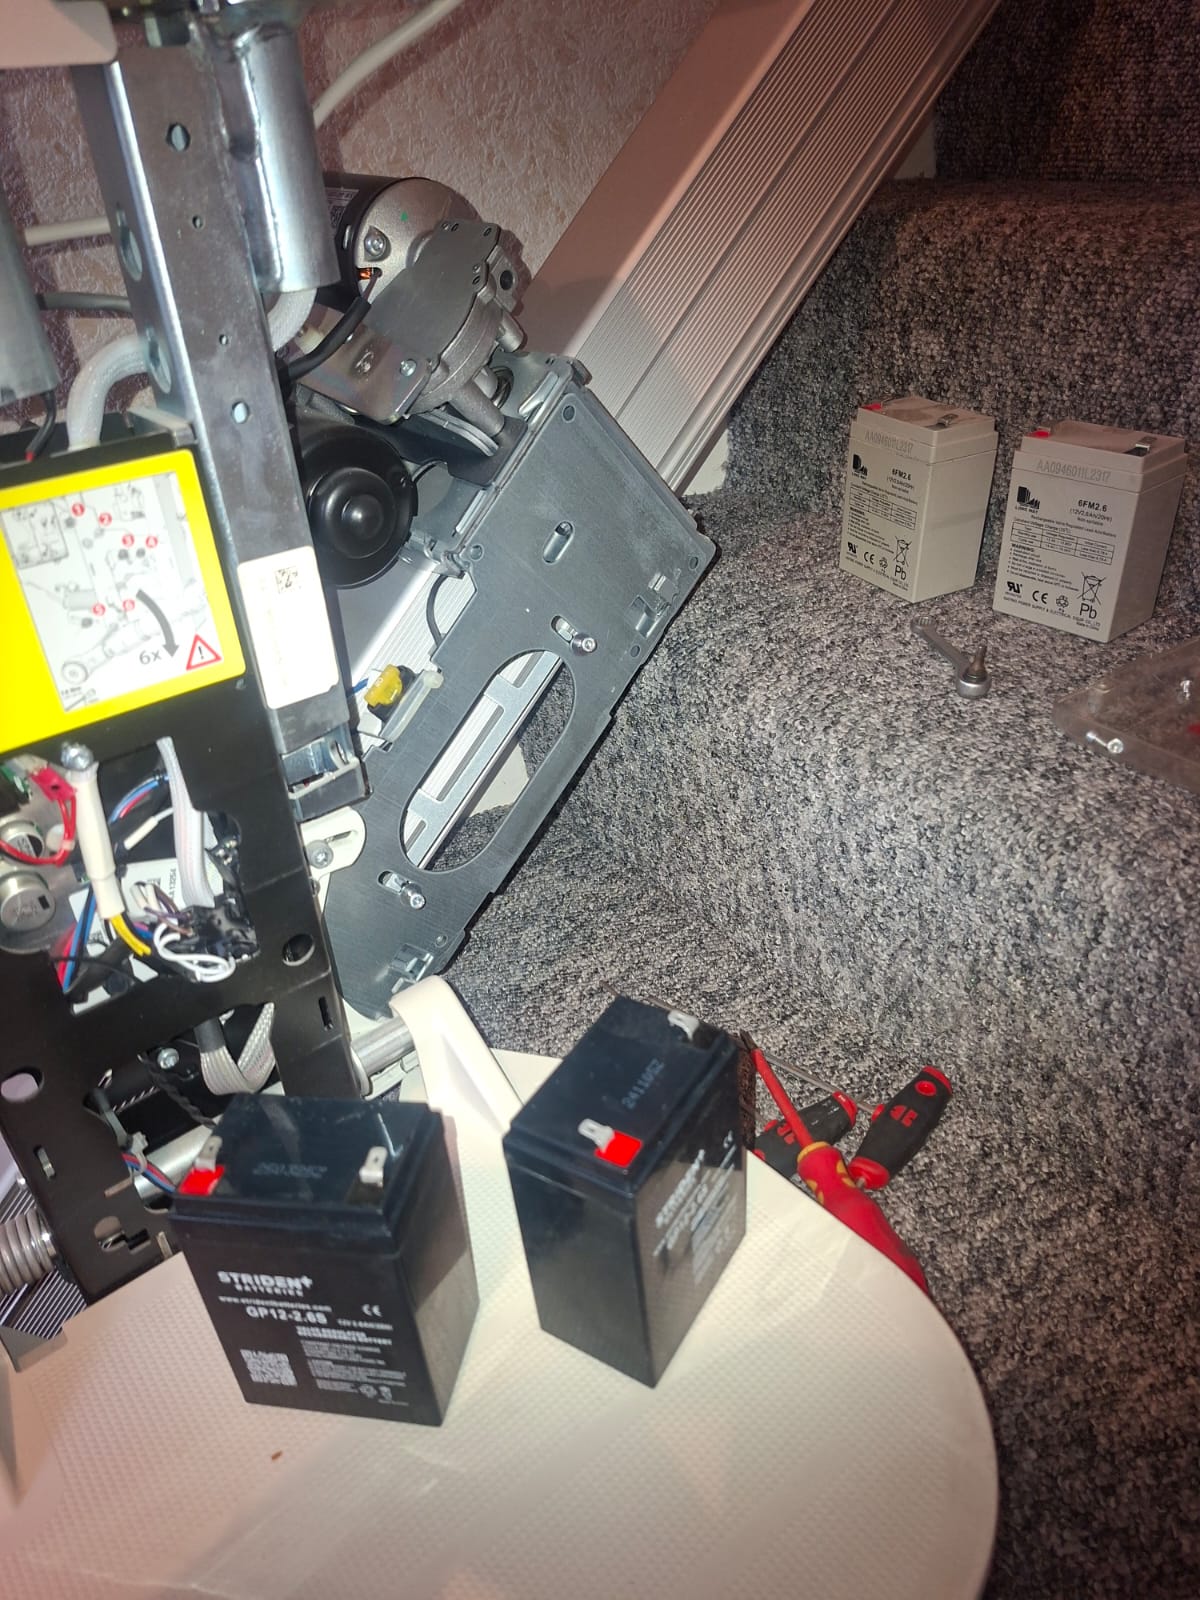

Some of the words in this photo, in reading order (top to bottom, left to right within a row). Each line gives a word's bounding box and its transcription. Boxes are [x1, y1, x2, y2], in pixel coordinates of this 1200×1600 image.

[1078, 499, 1108, 512] 6FM2.6
[895, 564, 907, 581] Pb
[1080, 602, 1098, 620] Pb
[139, 650, 162, 665] 6x
